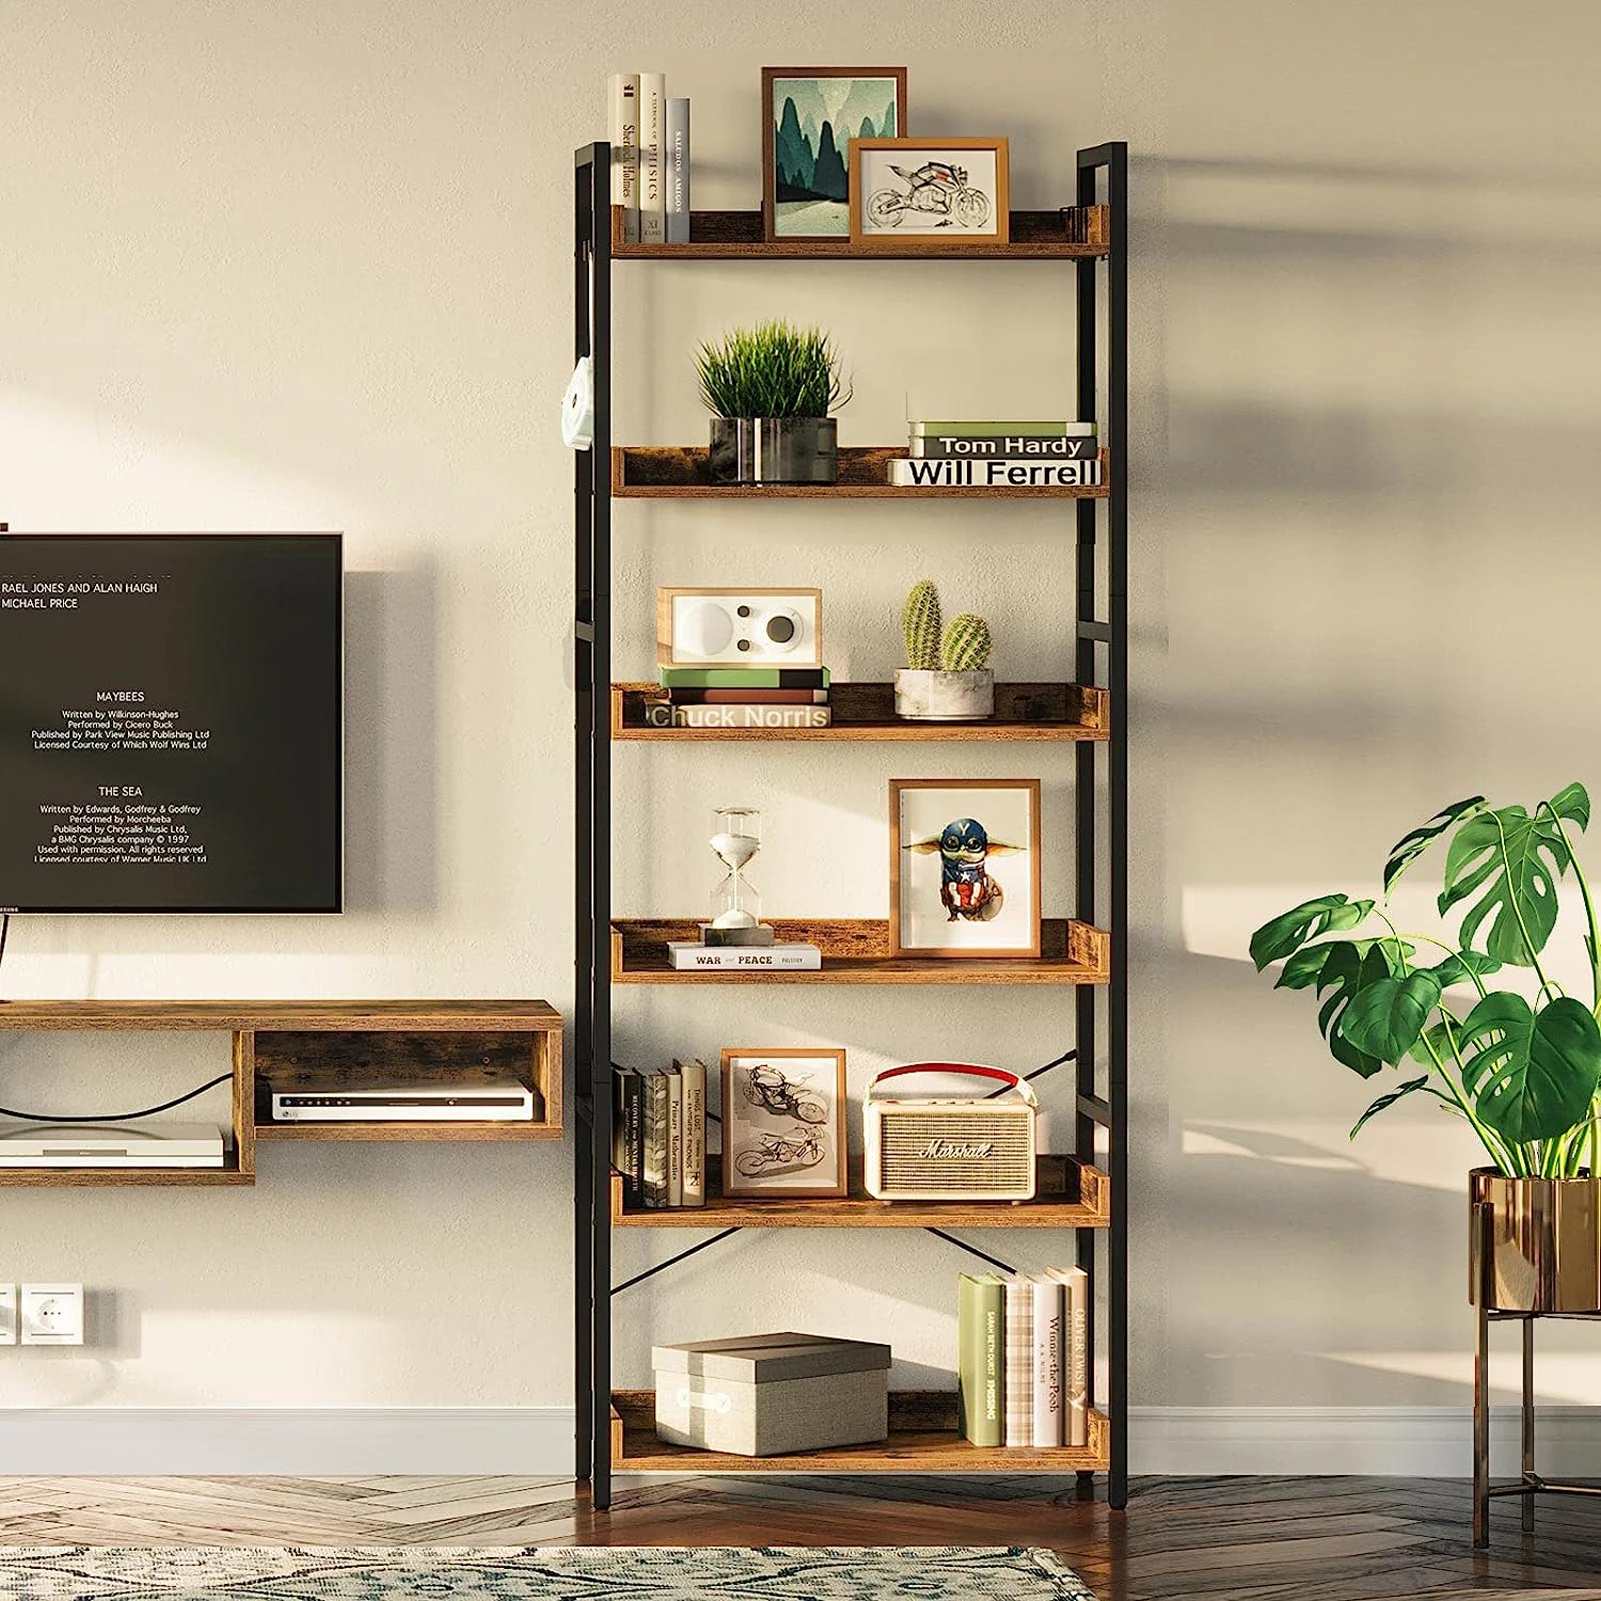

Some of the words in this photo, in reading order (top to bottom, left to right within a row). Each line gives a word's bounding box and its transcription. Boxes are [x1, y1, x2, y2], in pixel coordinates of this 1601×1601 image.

[622, 124, 634, 163] Sherlock
[622, 165, 634, 198] Holmes
[939, 438, 996, 454] Tom
[1005, 437, 1083, 458] Hardy
[909, 461, 973, 485] Will
[986, 461, 1096, 485] Ferrell
[2, 583, 28, 594] RAEL
[31, 583, 64, 594] JONES
[67, 583, 90, 594] AND
[93, 583, 122, 594] ALAN
[126, 583, 158, 594] HAIGH
[2, 598, 46, 608] MICHAEL
[50, 598, 78, 608] PRICE
[96, 692, 144, 702] MAYBEES
[62, 710, 94, 719] Written
[95, 710, 106, 722] by
[108, 710, 179, 722] Wilkinson-Hughes
[651, 706, 736, 727] Chuck
[744, 706, 828, 727] Norris
[68, 720, 110, 729] Performed
[112, 720, 124, 732] by
[125, 720, 150, 729] Cicero
[153, 720, 173, 729] Buck
[32, 730, 70, 739] Published
[72, 730, 82, 742] by
[84, 730, 102, 739] Park
[104, 730, 125, 739] View
[127, 730, 150, 739] Music
[152, 730, 192, 742] Publishing
[195, 730, 210, 739] Ltd
[34, 740, 70, 749] Licensed
[72, 740, 109, 752] Courtesy
[112, 740, 120, 749] of
[122, 740, 148, 749] Which
[150, 740, 168, 749] Wolf
[171, 740, 190, 749] Wins
[192, 740, 206, 749] Ltd
[98, 786, 118, 796] THE
[122, 786, 142, 796] SEA
[40, 805, 70, 814] Written
[73, 805, 84, 816] by
[124, 805, 157, 816] Godfrey
[159, 805, 166, 814] &
[168, 805, 201, 816] Godfrey
[70, 814, 112, 824] Performed
[114, 814, 124, 826] by
[126, 814, 172, 824] Morcheeba
[54, 825, 92, 833] Published
[94, 825, 105, 836] by
[106, 825, 144, 836] Chrysalis
[146, 825, 168, 833] Music
[52, 834, 58, 843] a
[59, 834, 76, 843] BMG
[78, 834, 114, 846] Chrysalis
[117, 834, 154, 846] company
[168, 834, 190, 843] 1997
[38, 844, 58, 853] Used
[60, 844, 78, 853] with
[128, 844, 140, 853] All
[142, 844, 166, 856] rights
[168, 844, 204, 853] reserved
[696, 956, 721, 964] WAR
[738, 956, 772, 964] PEACE
[918, 1139, 993, 1159] Marshall
[1075, 1308, 1086, 1351] OLIVER
[1075, 1352, 1086, 1385] TWIST
